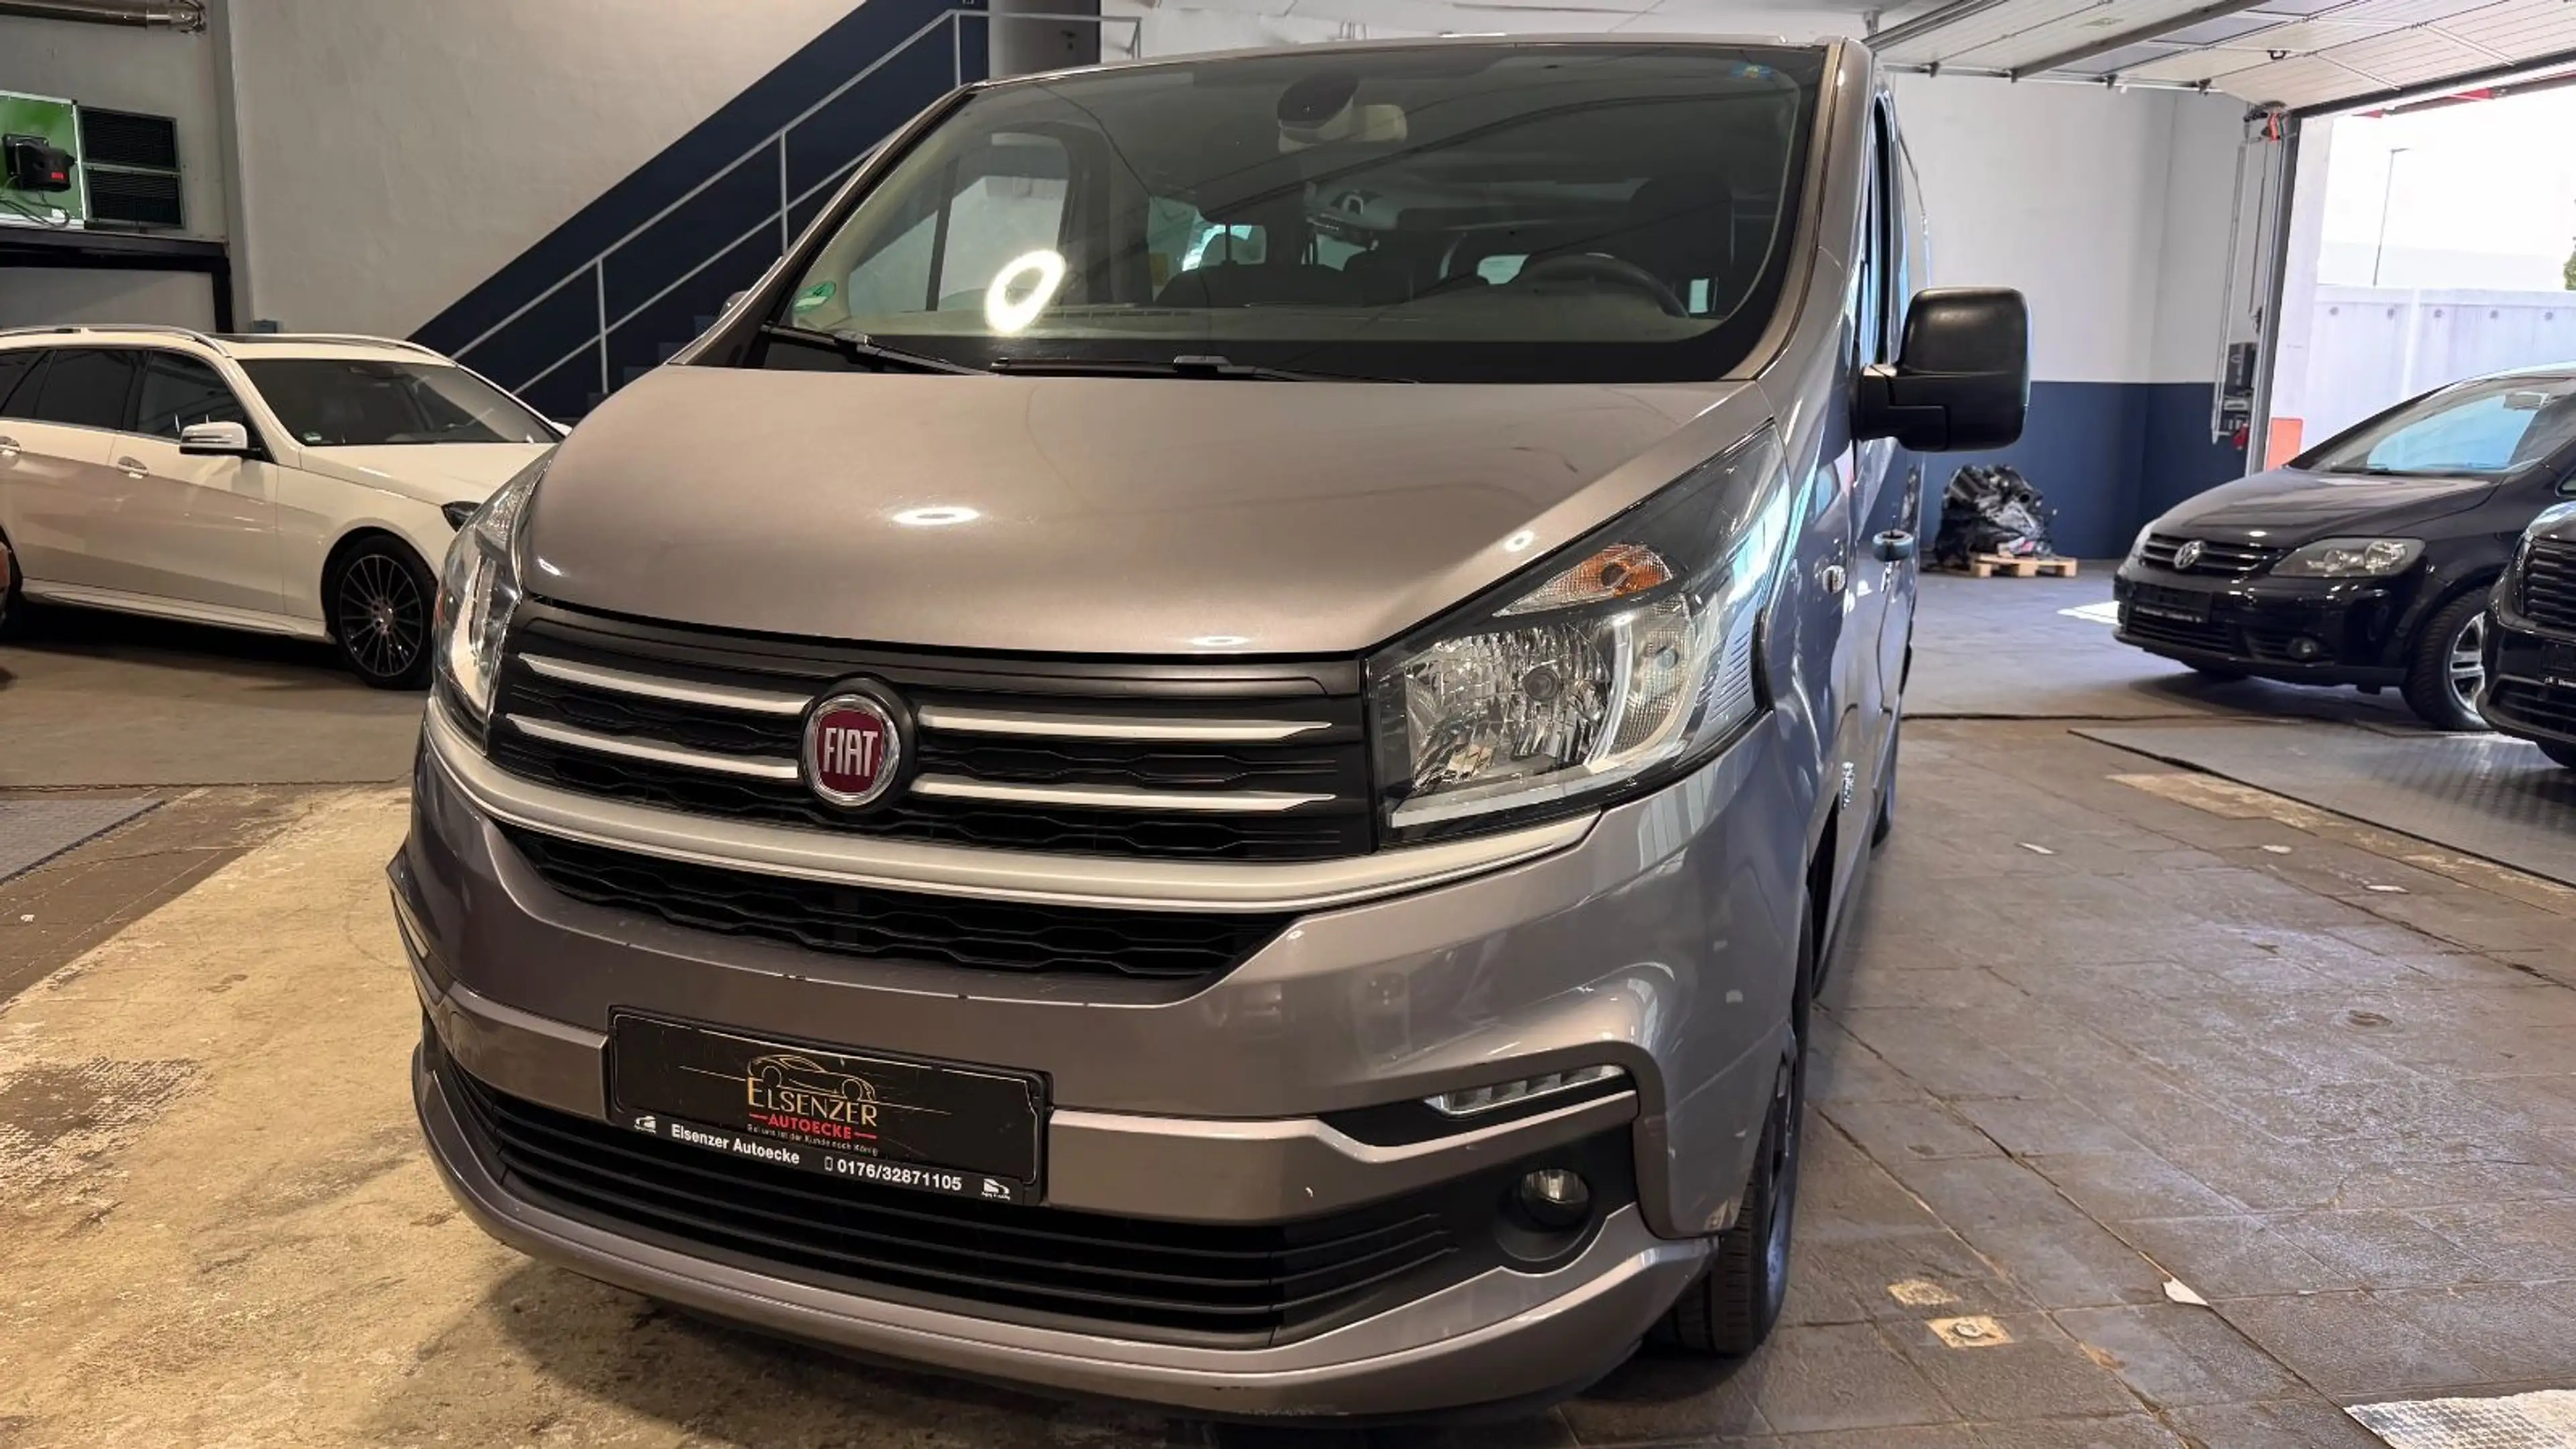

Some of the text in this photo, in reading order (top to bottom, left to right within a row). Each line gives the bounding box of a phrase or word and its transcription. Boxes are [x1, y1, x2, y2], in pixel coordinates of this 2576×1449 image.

[822, 727, 878, 777] FIAT
[747, 1077, 877, 1127] ELSENZER
[672, 1124, 800, 1165] Elsenzer Autoecke
[768, 1114, 851, 1139] AUTOECKE
[837, 1159, 963, 1191] 0176/32871105
